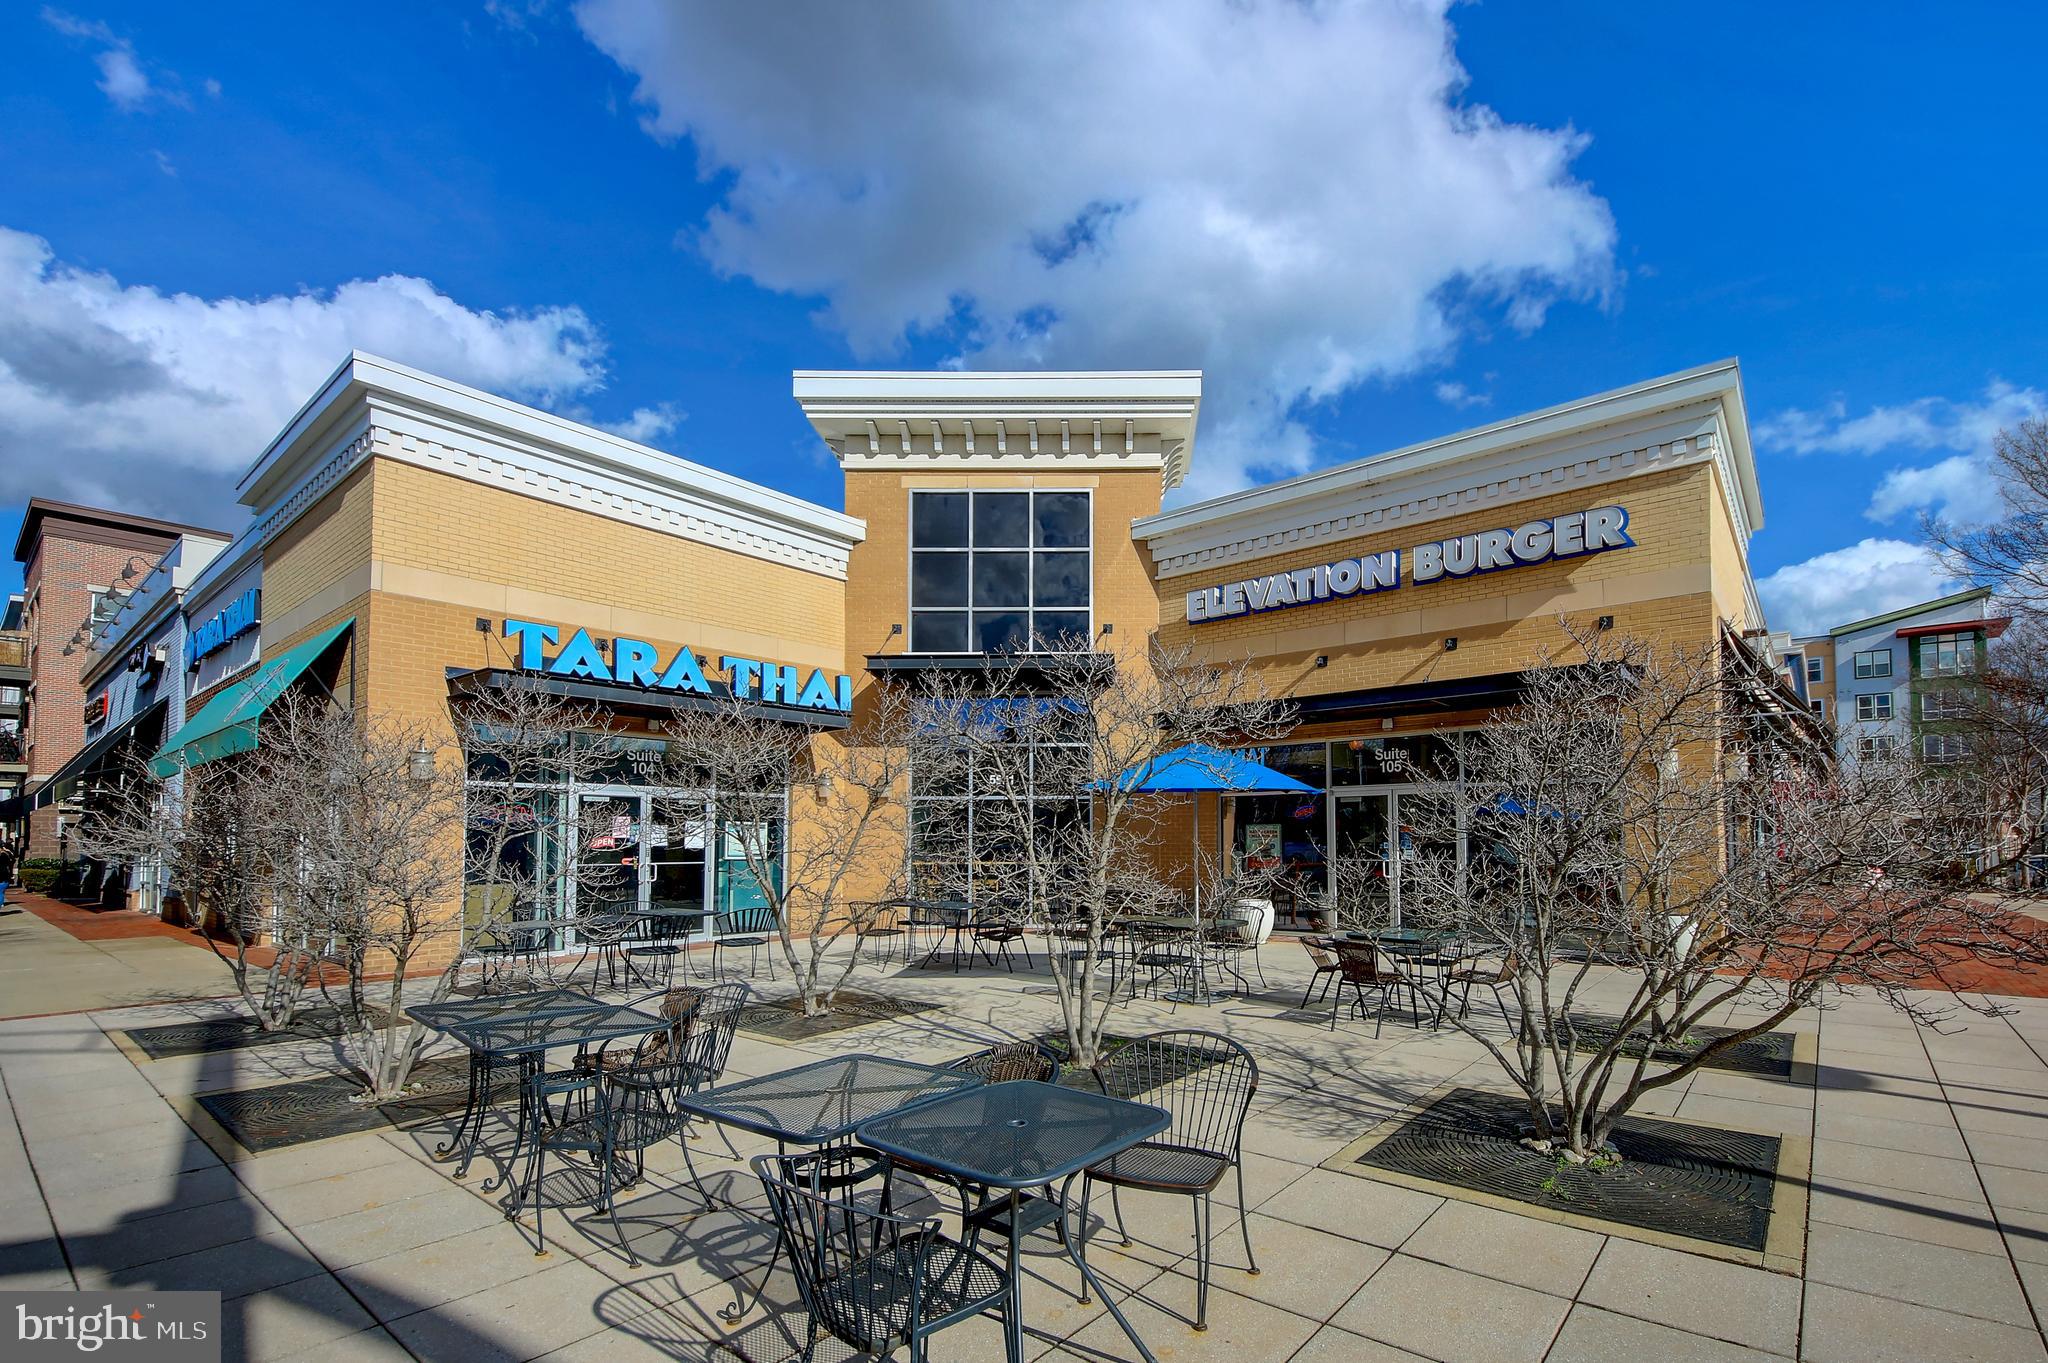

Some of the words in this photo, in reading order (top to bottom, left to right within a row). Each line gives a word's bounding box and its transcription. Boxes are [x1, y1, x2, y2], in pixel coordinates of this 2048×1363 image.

[1186, 550, 1400, 624] ELEVATION
[1413, 505, 1634, 584] BURGER
[502, 618, 712, 694] TARA
[719, 655, 852, 712] THAI
[627, 750, 662, 762] Suite
[1374, 748, 1408, 760] Suite
[631, 762, 656, 775] 104
[1380, 761, 1402, 773] 105
